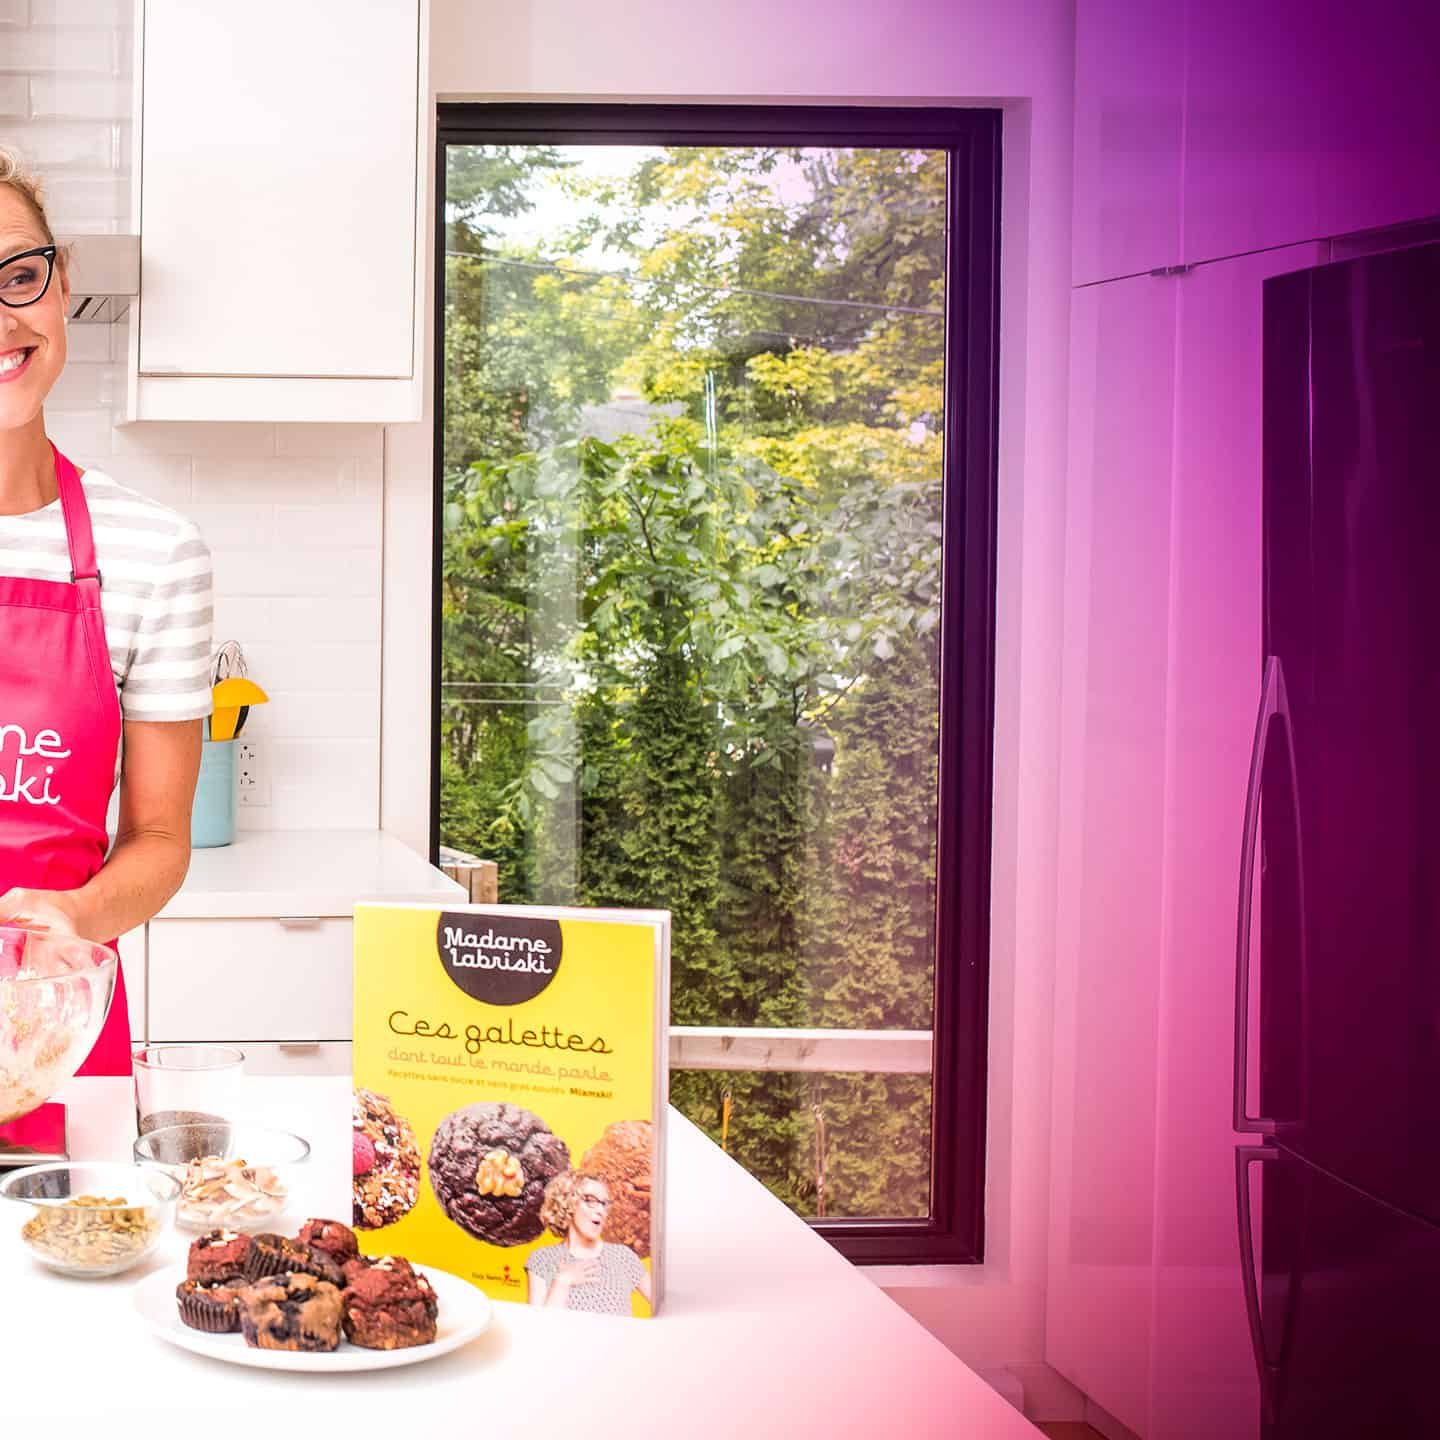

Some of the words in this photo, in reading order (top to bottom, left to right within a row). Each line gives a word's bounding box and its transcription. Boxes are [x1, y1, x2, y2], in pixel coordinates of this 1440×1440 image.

[443, 927, 553, 954] Madame
[449, 948, 553, 974] Labriski
[388, 1011, 457, 1039] Ces
[464, 1018, 614, 1054] galettes
[388, 1048, 428, 1063] dont
[431, 1053, 466, 1067] tout
[469, 1054, 489, 1069] le
[558, 1065, 614, 1083] parle
